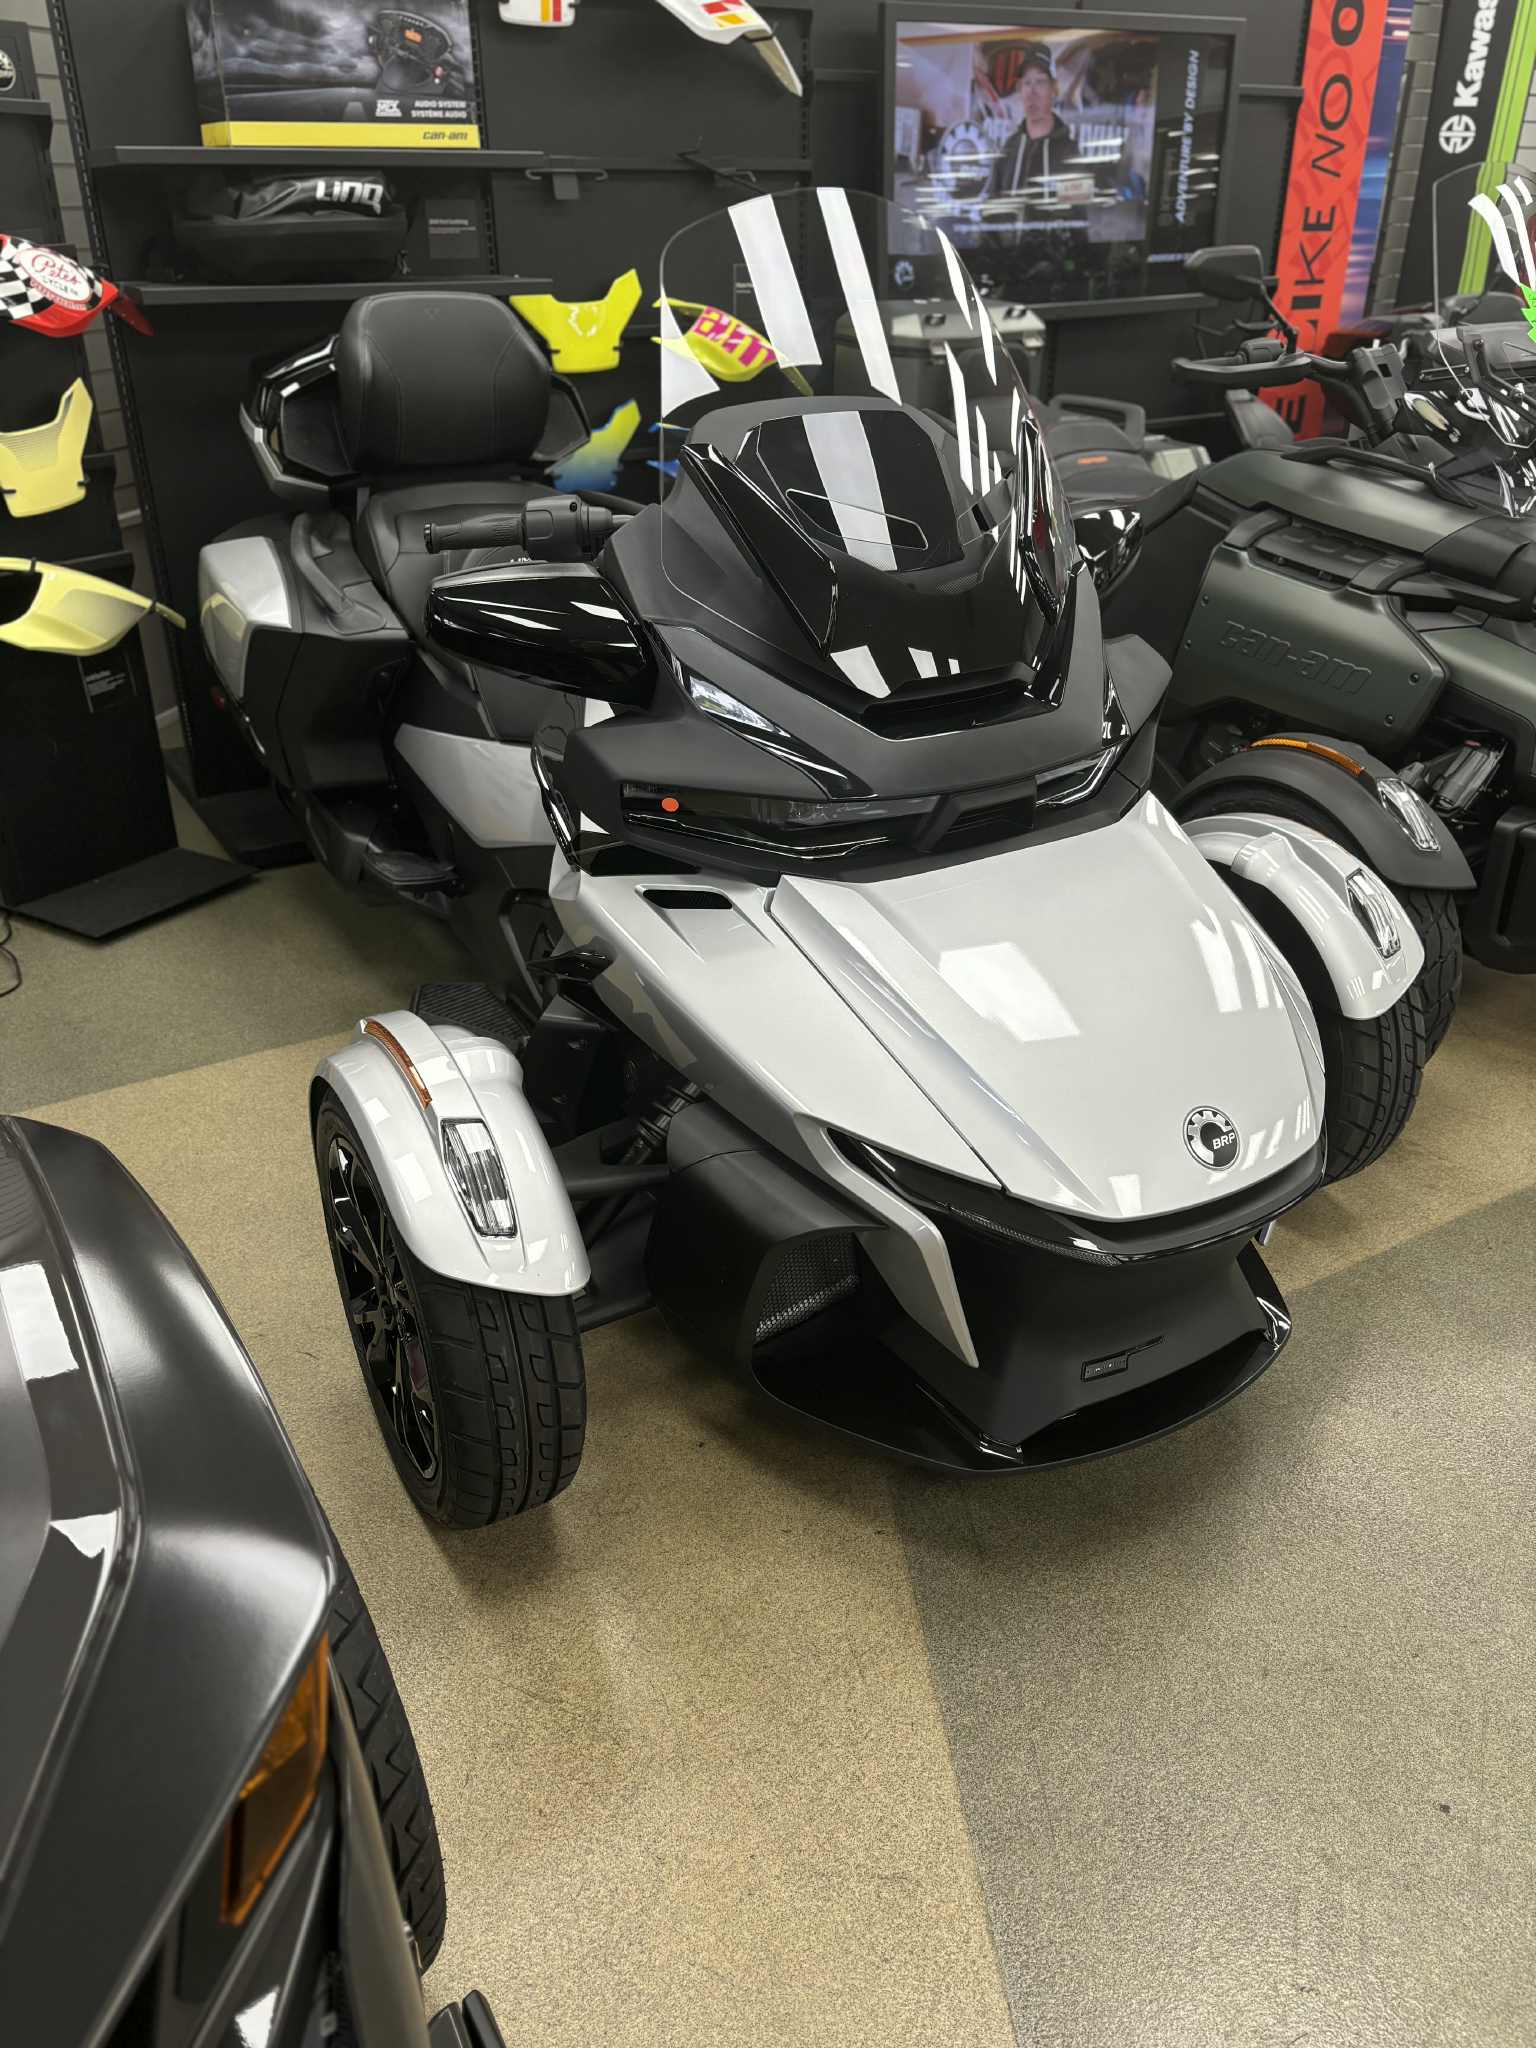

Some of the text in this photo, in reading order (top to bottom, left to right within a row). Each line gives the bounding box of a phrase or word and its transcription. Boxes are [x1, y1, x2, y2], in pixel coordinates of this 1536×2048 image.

[1174, 49, 1200, 224] ADVENTURE BY DESIGN
[1311, 73, 1353, 178] NO
[1217, 620, 1373, 696] can-am
[1212, 1132, 1236, 1150] BRP
